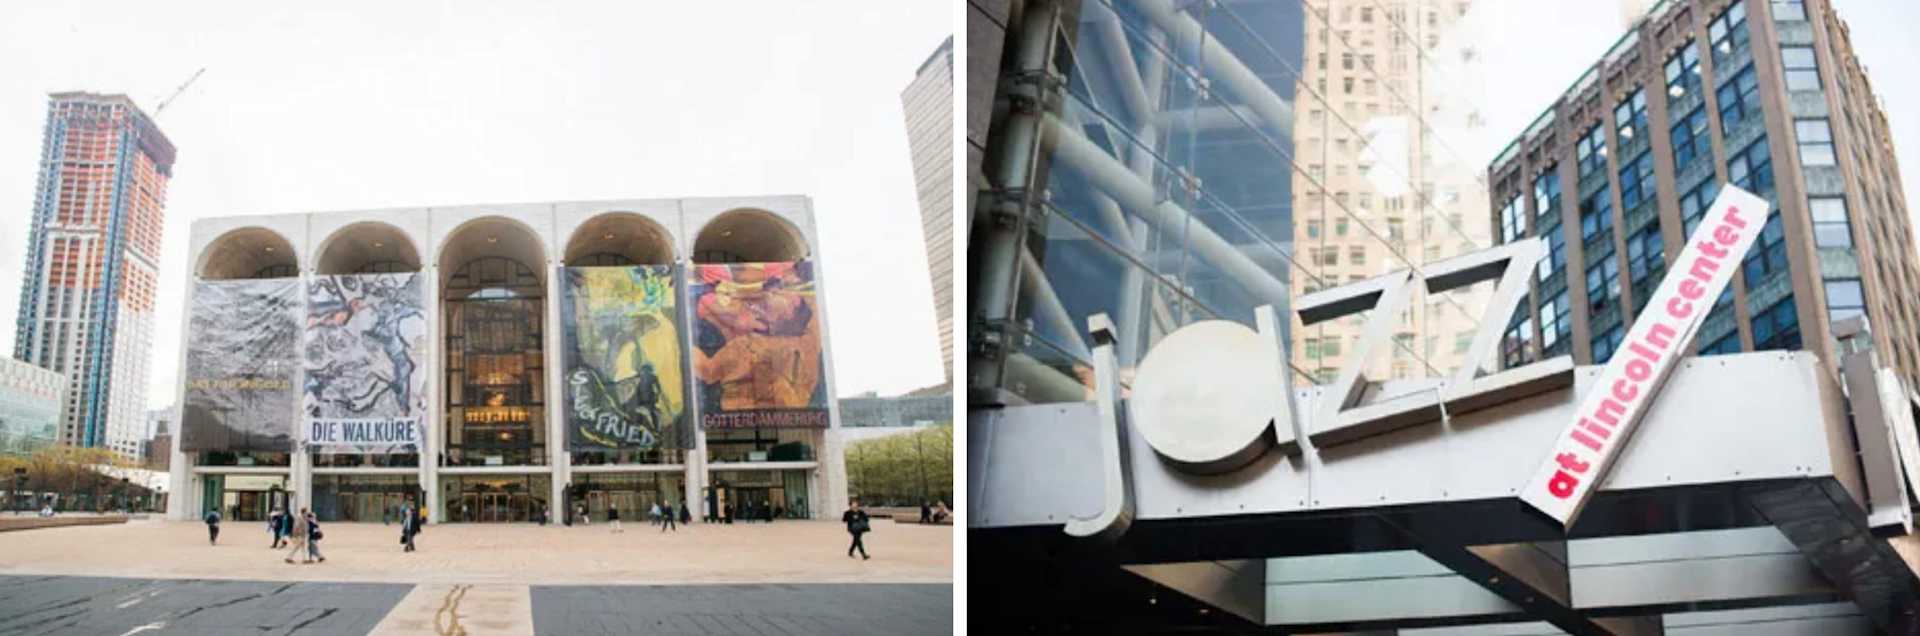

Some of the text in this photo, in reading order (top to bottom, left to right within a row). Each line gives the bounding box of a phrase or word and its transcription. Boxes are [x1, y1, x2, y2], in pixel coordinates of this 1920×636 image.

[312, 418, 415, 441] DIE WALKÜRE
[1063, 236, 1575, 537] jazz
[1547, 205, 1748, 499] at lincoln center
